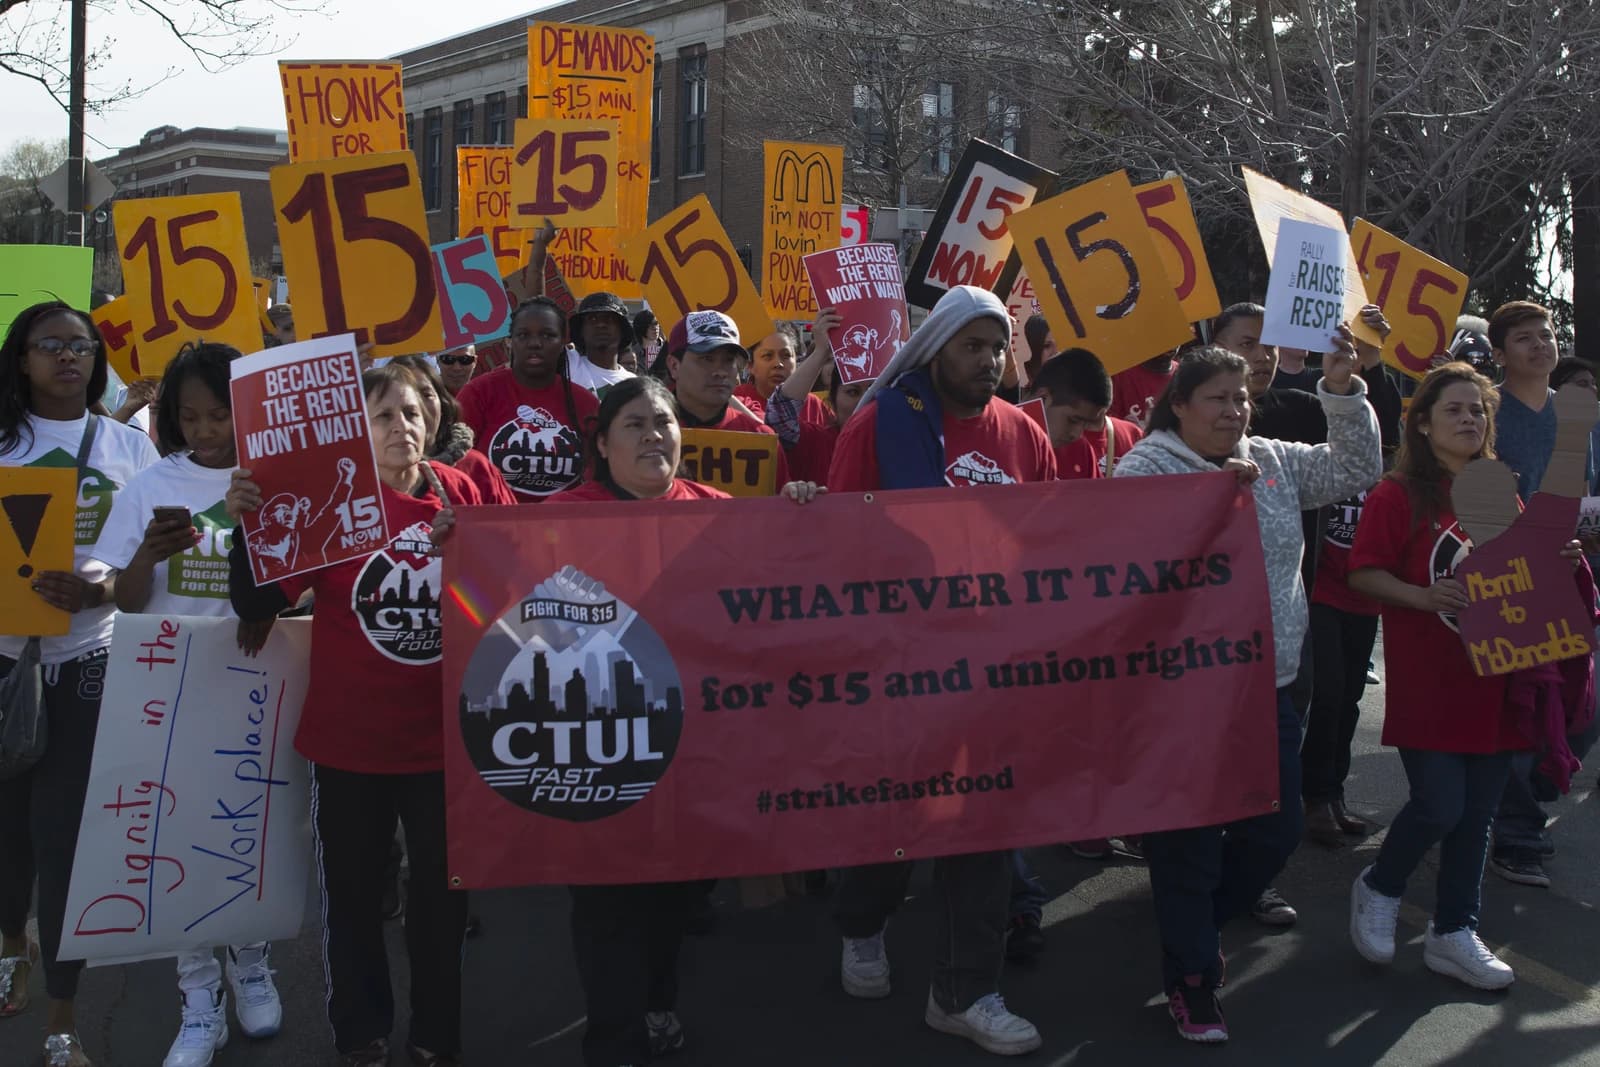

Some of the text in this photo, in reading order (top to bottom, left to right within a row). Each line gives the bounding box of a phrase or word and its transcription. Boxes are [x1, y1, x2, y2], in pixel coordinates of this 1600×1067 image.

[541, 26, 652, 74] DEMANDS:
[297, 76, 396, 128] HONK
[331, 132, 375, 157] FOR
[515, 130, 610, 216] 15
[617, 160, 643, 181] CK
[798, 211, 834, 232] NOT
[841, 208, 862, 244] 5
[957, 176, 1025, 240] 15
[281, 162, 437, 345] 15
[555, 227, 598, 252] AIR
[836, 246, 896, 266] BECAUSE
[1136, 184, 1196, 300] 5
[1300, 241, 1324, 259] RALLY
[123, 209, 238, 342] 15
[640, 209, 738, 317] 15
[769, 252, 808, 283] POVE
[837, 264, 899, 283] THE RENT
[928, 242, 1004, 290] NOW
[1035, 211, 1140, 338] 15
[769, 283, 818, 313] WAGE
[826, 281, 903, 304] WON'T WAIT
[1290, 296, 1344, 330] RESPE
[265, 356, 355, 397] BECAUSE
[262, 384, 358, 426] THE RENT
[246, 412, 364, 460] WON'T WAIT
[502, 454, 576, 476] CTUL
[680, 445, 769, 487] GHT
[335, 495, 381, 533] 15
[1332, 523, 1355, 531] FAS
[718, 553, 1232, 624] WHATEVER IT TAKES
[525, 601, 613, 622] FIGHT FOR $15
[1499, 600, 1527, 624] to
[395, 629, 438, 641] FAST
[1470, 618, 1590, 676] McDonalds
[701, 630, 1263, 712] for $15 and union rights!
[492, 716, 664, 766] CTUL
[74, 618, 184, 936] Dignity in the
[529, 767, 602, 785] FAST
[531, 785, 616, 802] FOOD
[756, 766, 1015, 814] #strikefastfood
